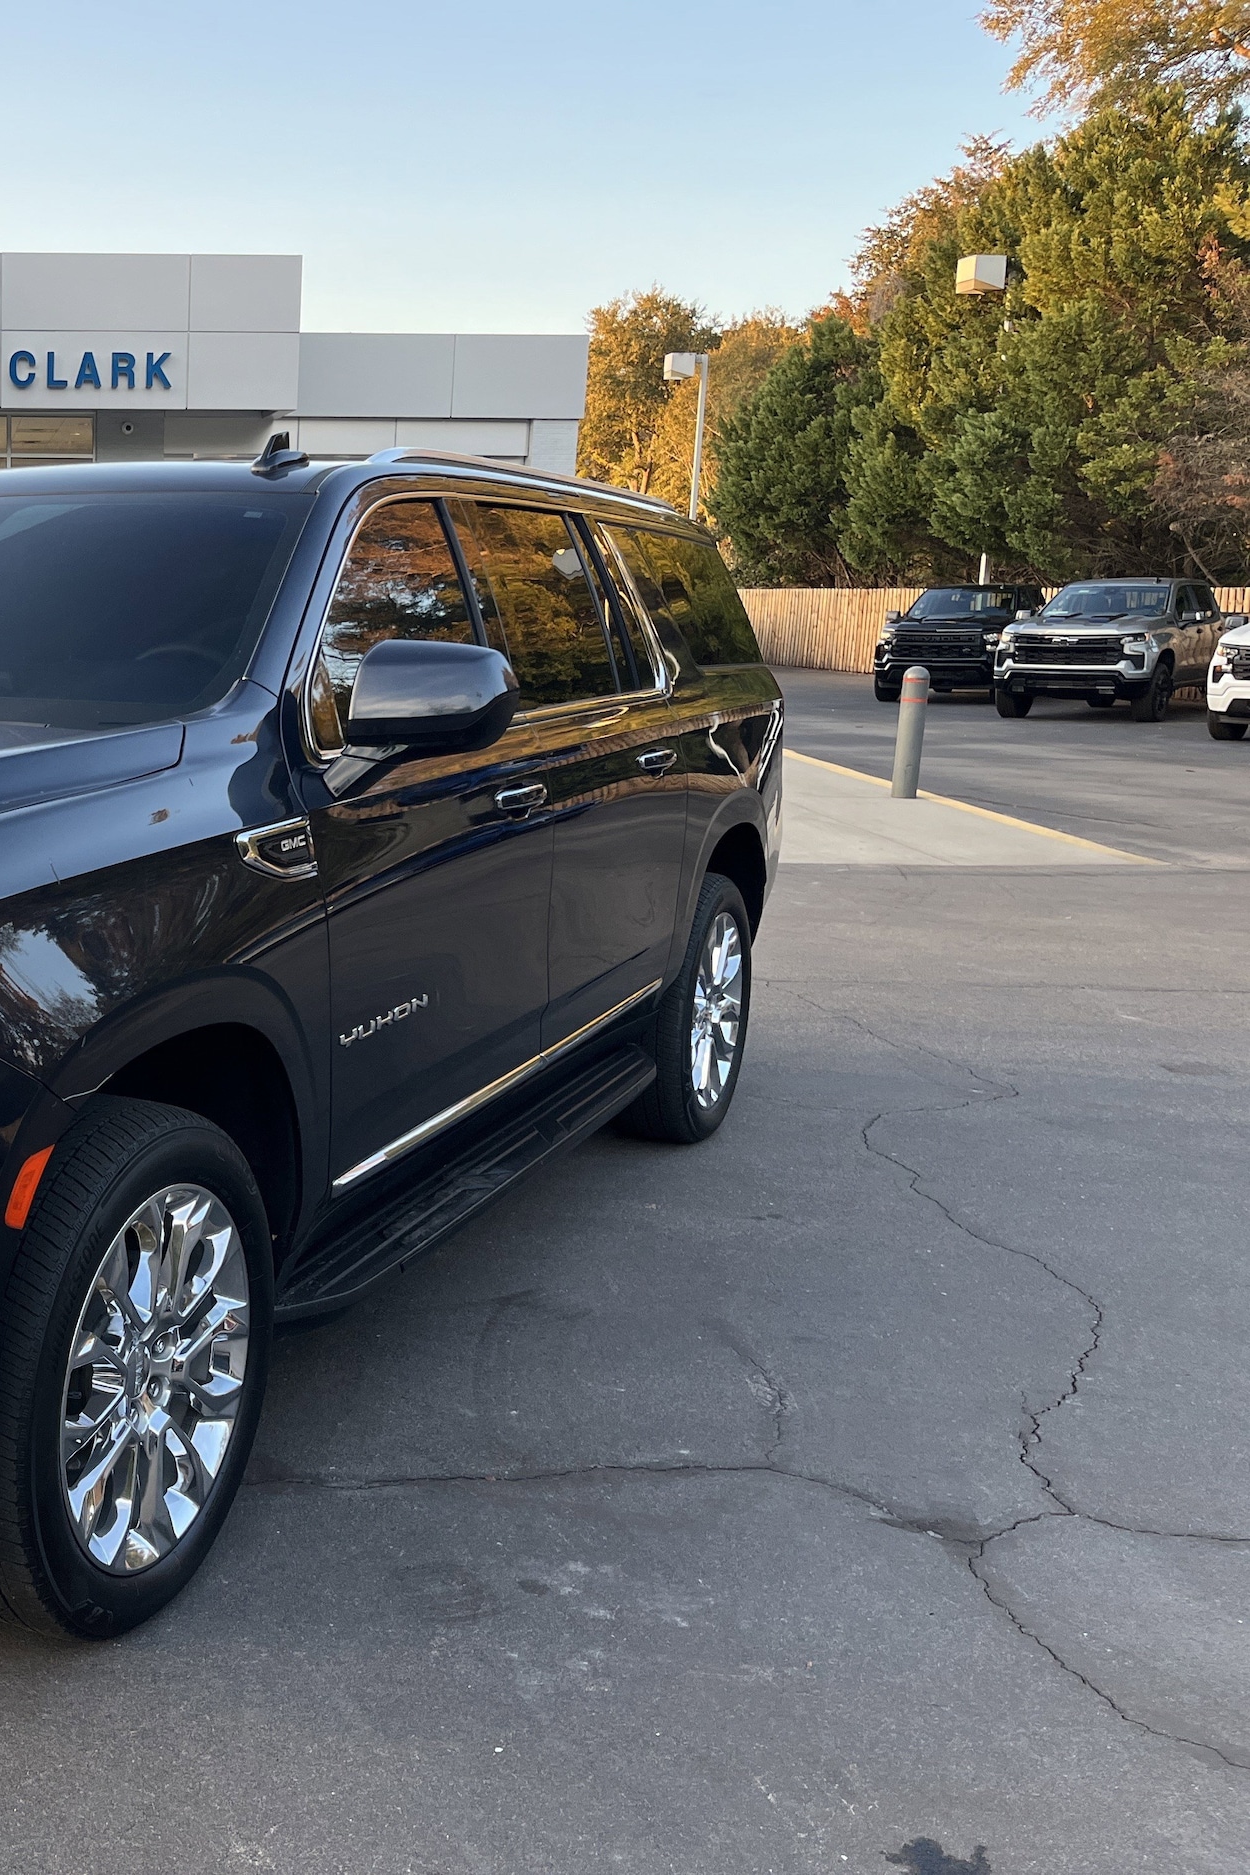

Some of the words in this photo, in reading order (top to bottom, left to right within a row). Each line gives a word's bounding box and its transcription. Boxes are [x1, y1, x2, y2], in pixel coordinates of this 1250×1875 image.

[9, 350, 172, 389] CLARK
[280, 834, 307, 852] GMC
[339, 993, 429, 1048] YUKON
